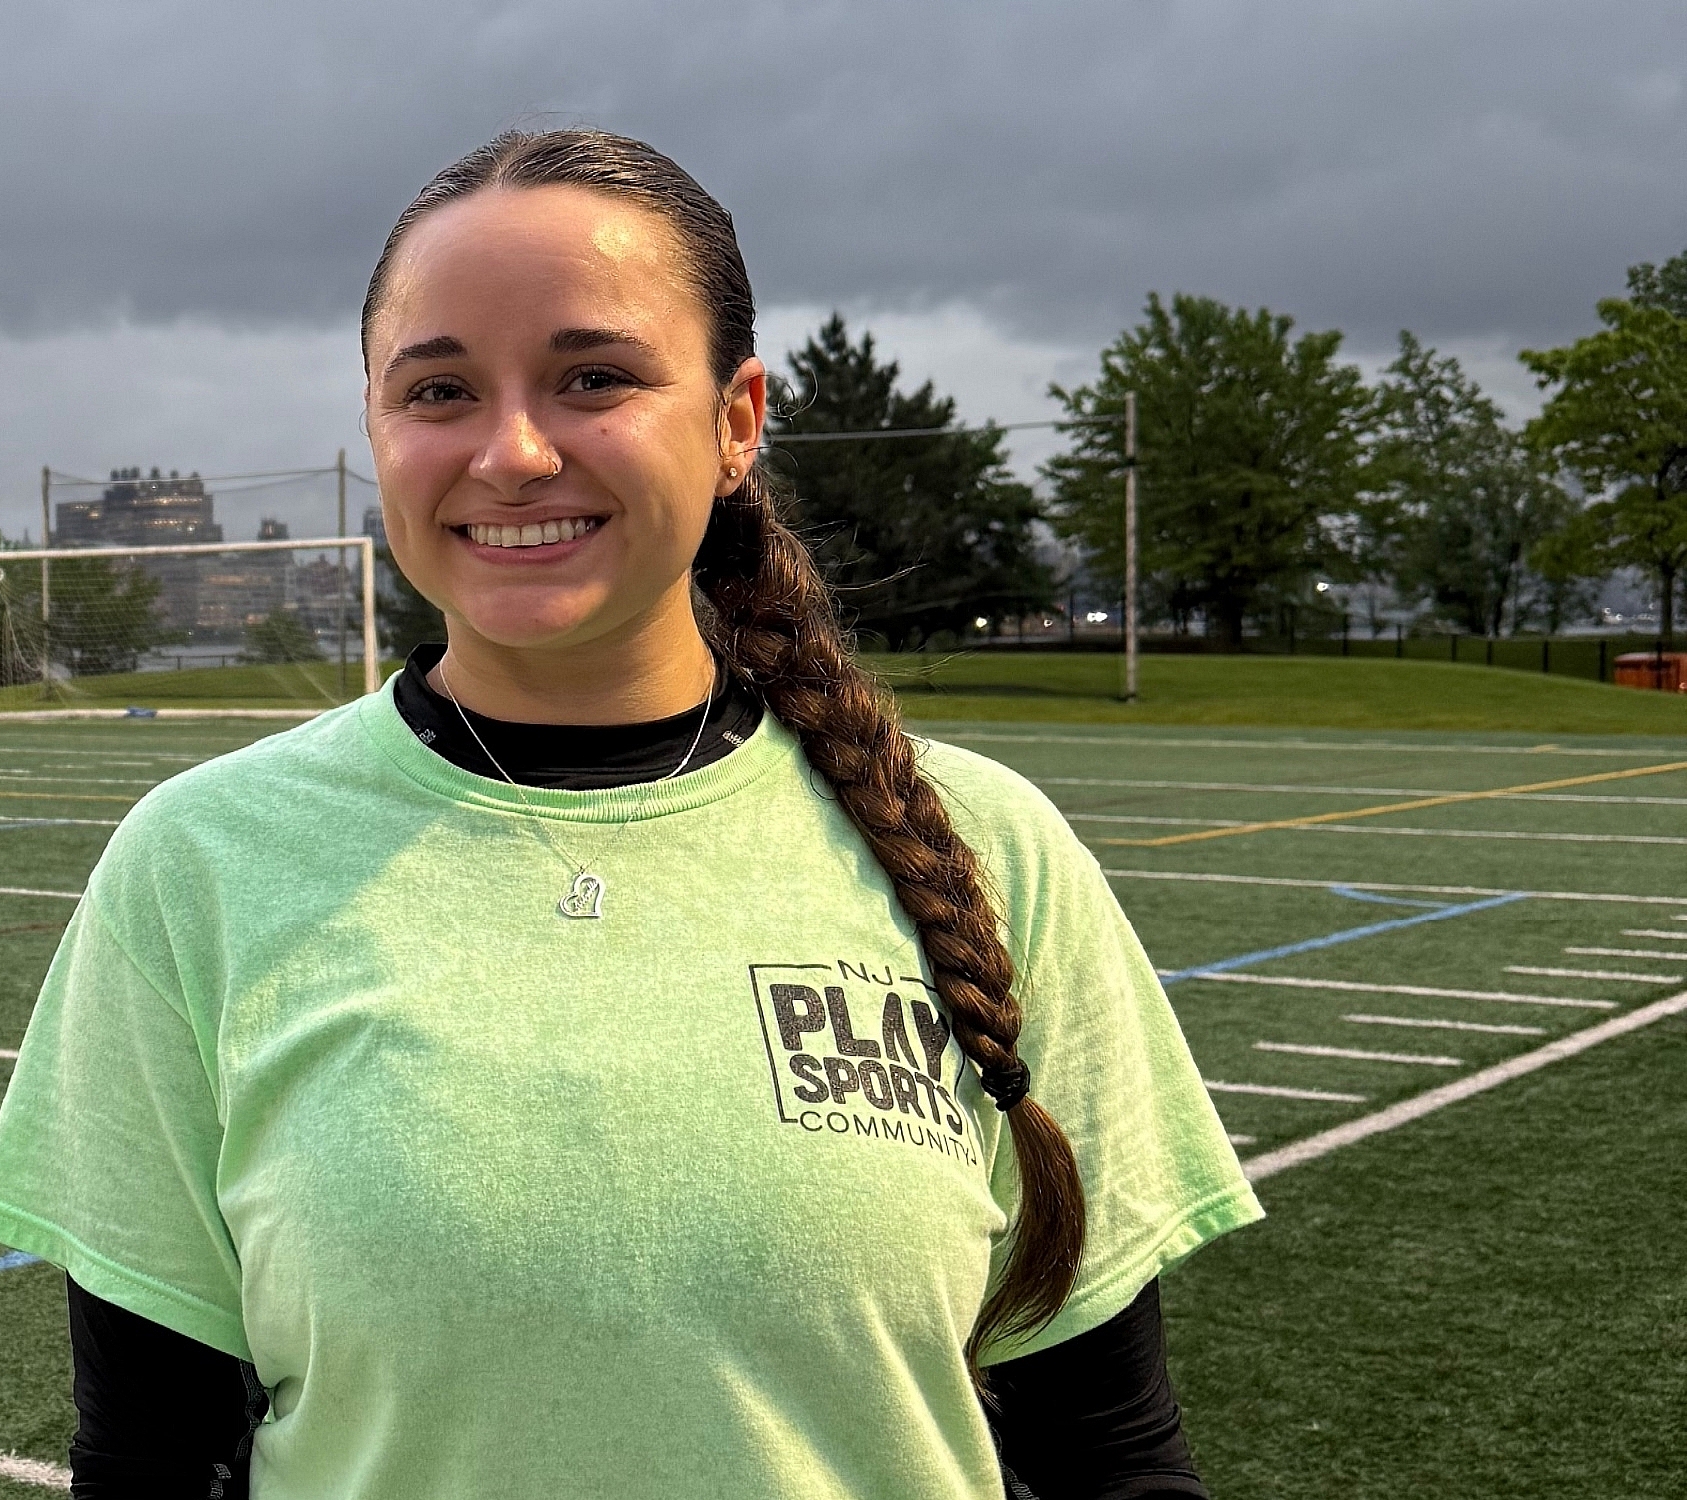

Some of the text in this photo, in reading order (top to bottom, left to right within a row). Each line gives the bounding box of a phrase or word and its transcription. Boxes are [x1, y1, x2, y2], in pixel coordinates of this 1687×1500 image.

[837, 960, 893, 985] NJ
[770, 983, 950, 1082] PLAY
[789, 1054, 963, 1136] SPORTS
[799, 1111, 971, 1166] COMMUNITY
